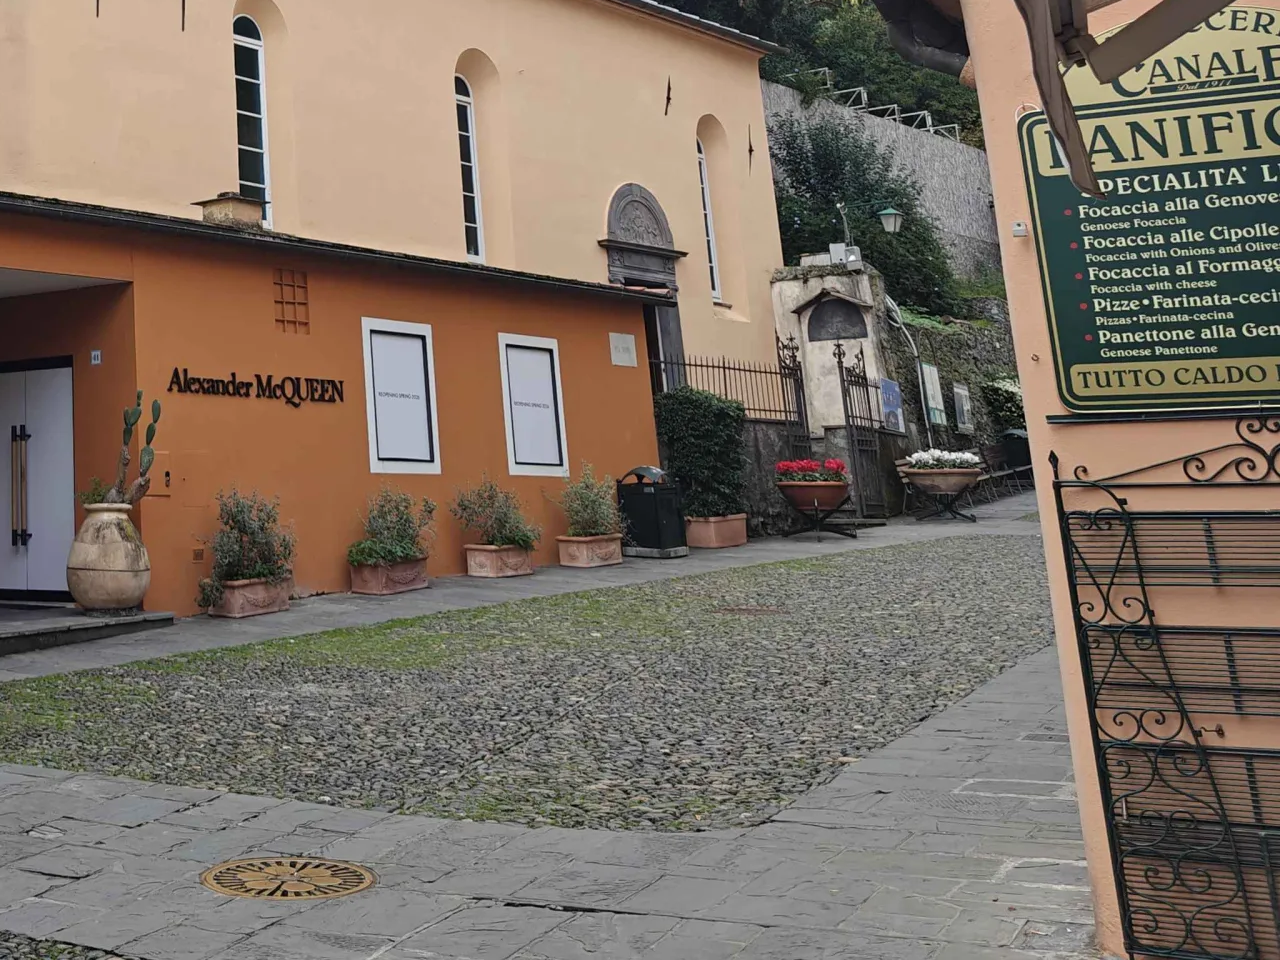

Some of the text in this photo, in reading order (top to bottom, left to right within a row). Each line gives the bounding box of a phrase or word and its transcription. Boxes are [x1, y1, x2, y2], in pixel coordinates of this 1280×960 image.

[1081, 166, 1247, 197] PECIALITA'
[1078, 192, 1280, 219] Focaccia alla Genove
[1080, 216, 1187, 232] Genoese Focaccia
[1082, 222, 1280, 250] Focaccia alle Cipolle
[1085, 241, 1280, 263] Focaccia with Onions and Olive
[1087, 263, 1170, 280] Focaccia
[1175, 261, 1193, 275] al
[1090, 279, 1217, 294] Focaccia with cheese
[1092, 288, 1280, 312] Pizze Farinata-ceci
[1095, 310, 1235, 326] Pizzas Farinata-cecina
[1097, 328, 1195, 344] Panettone
[1200, 324, 1238, 339] alla
[1100, 345, 1218, 358] Genoese Panettone
[167, 366, 344, 408] Alexander McQUEEN
[1077, 368, 1165, 389] TUTTO
[1173, 364, 1267, 385] CALDO
